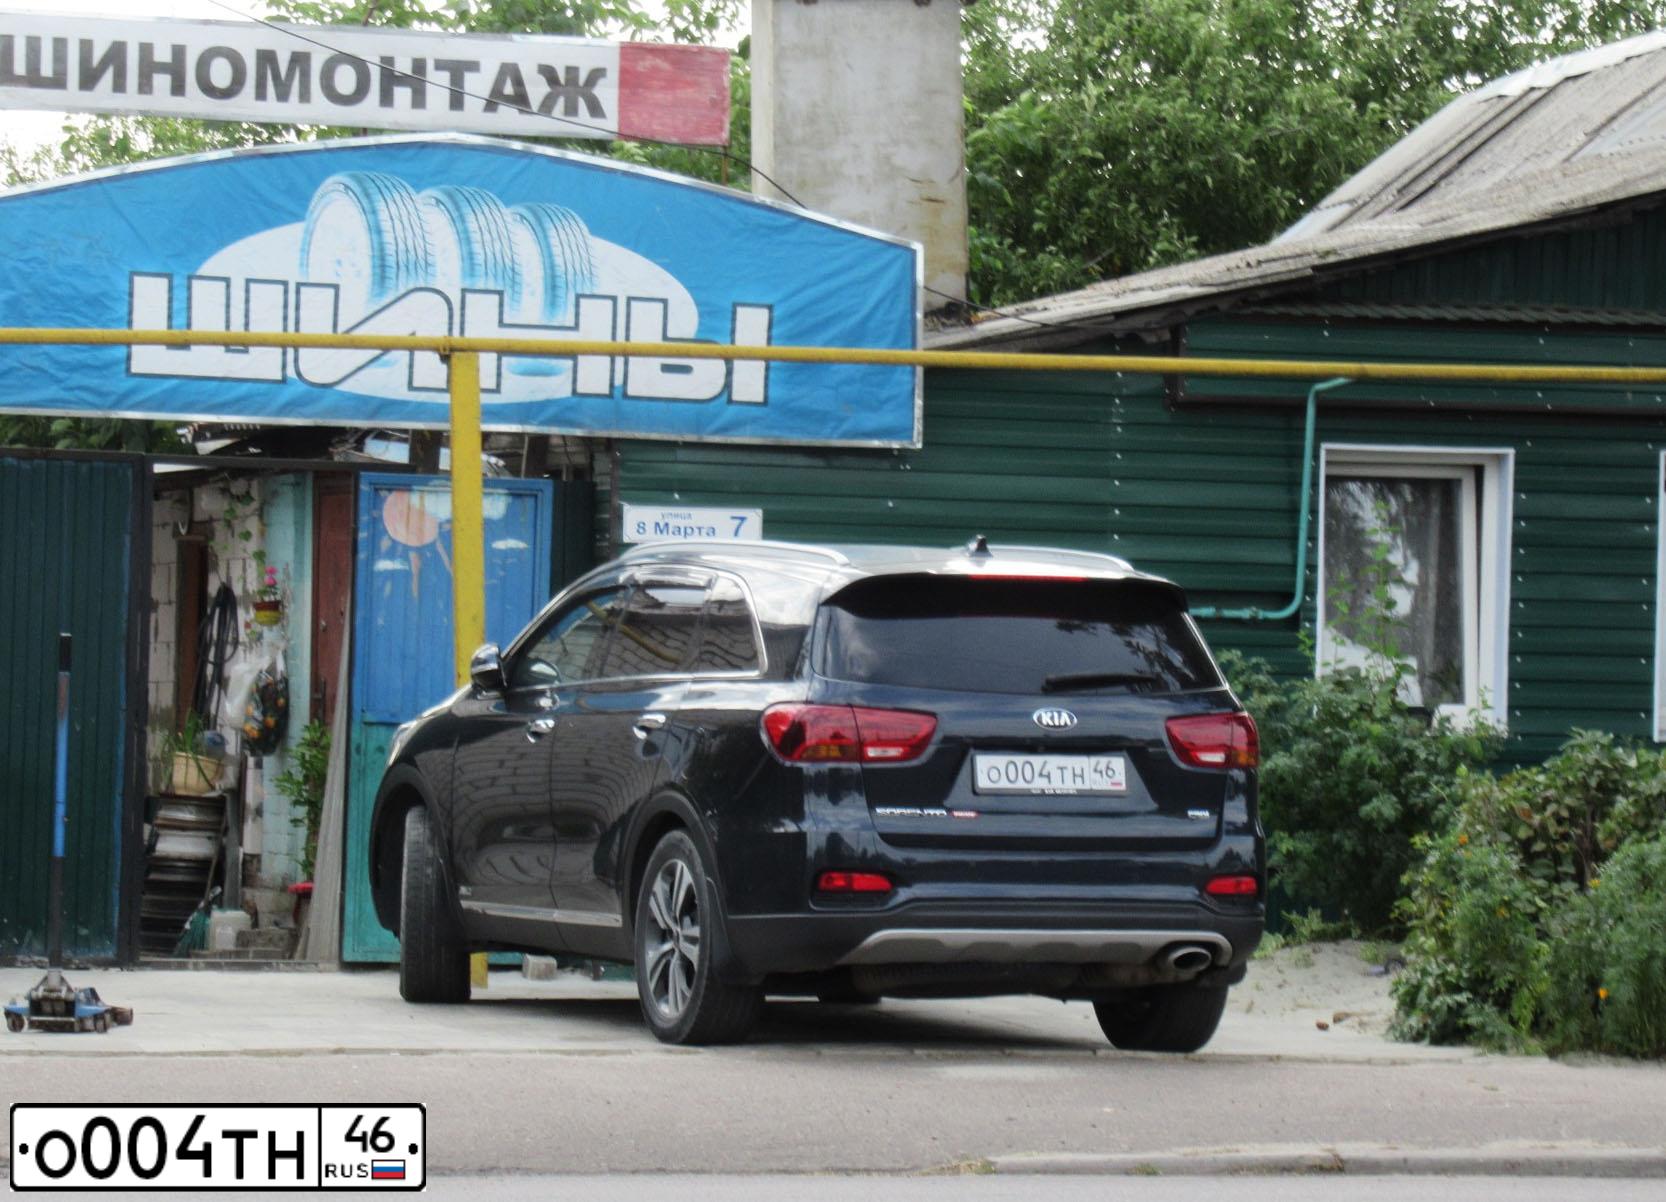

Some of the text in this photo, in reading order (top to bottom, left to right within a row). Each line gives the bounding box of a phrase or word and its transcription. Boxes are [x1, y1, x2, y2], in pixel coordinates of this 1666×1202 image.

[0, 33, 609, 121] ШИНОМОНТАЖ
[127, 271, 775, 406] ШИНЫ
[636, 515, 748, 539] 8 Марта 7
[1041, 711, 1072, 726] KIA
[1093, 760, 1116, 779] 46
